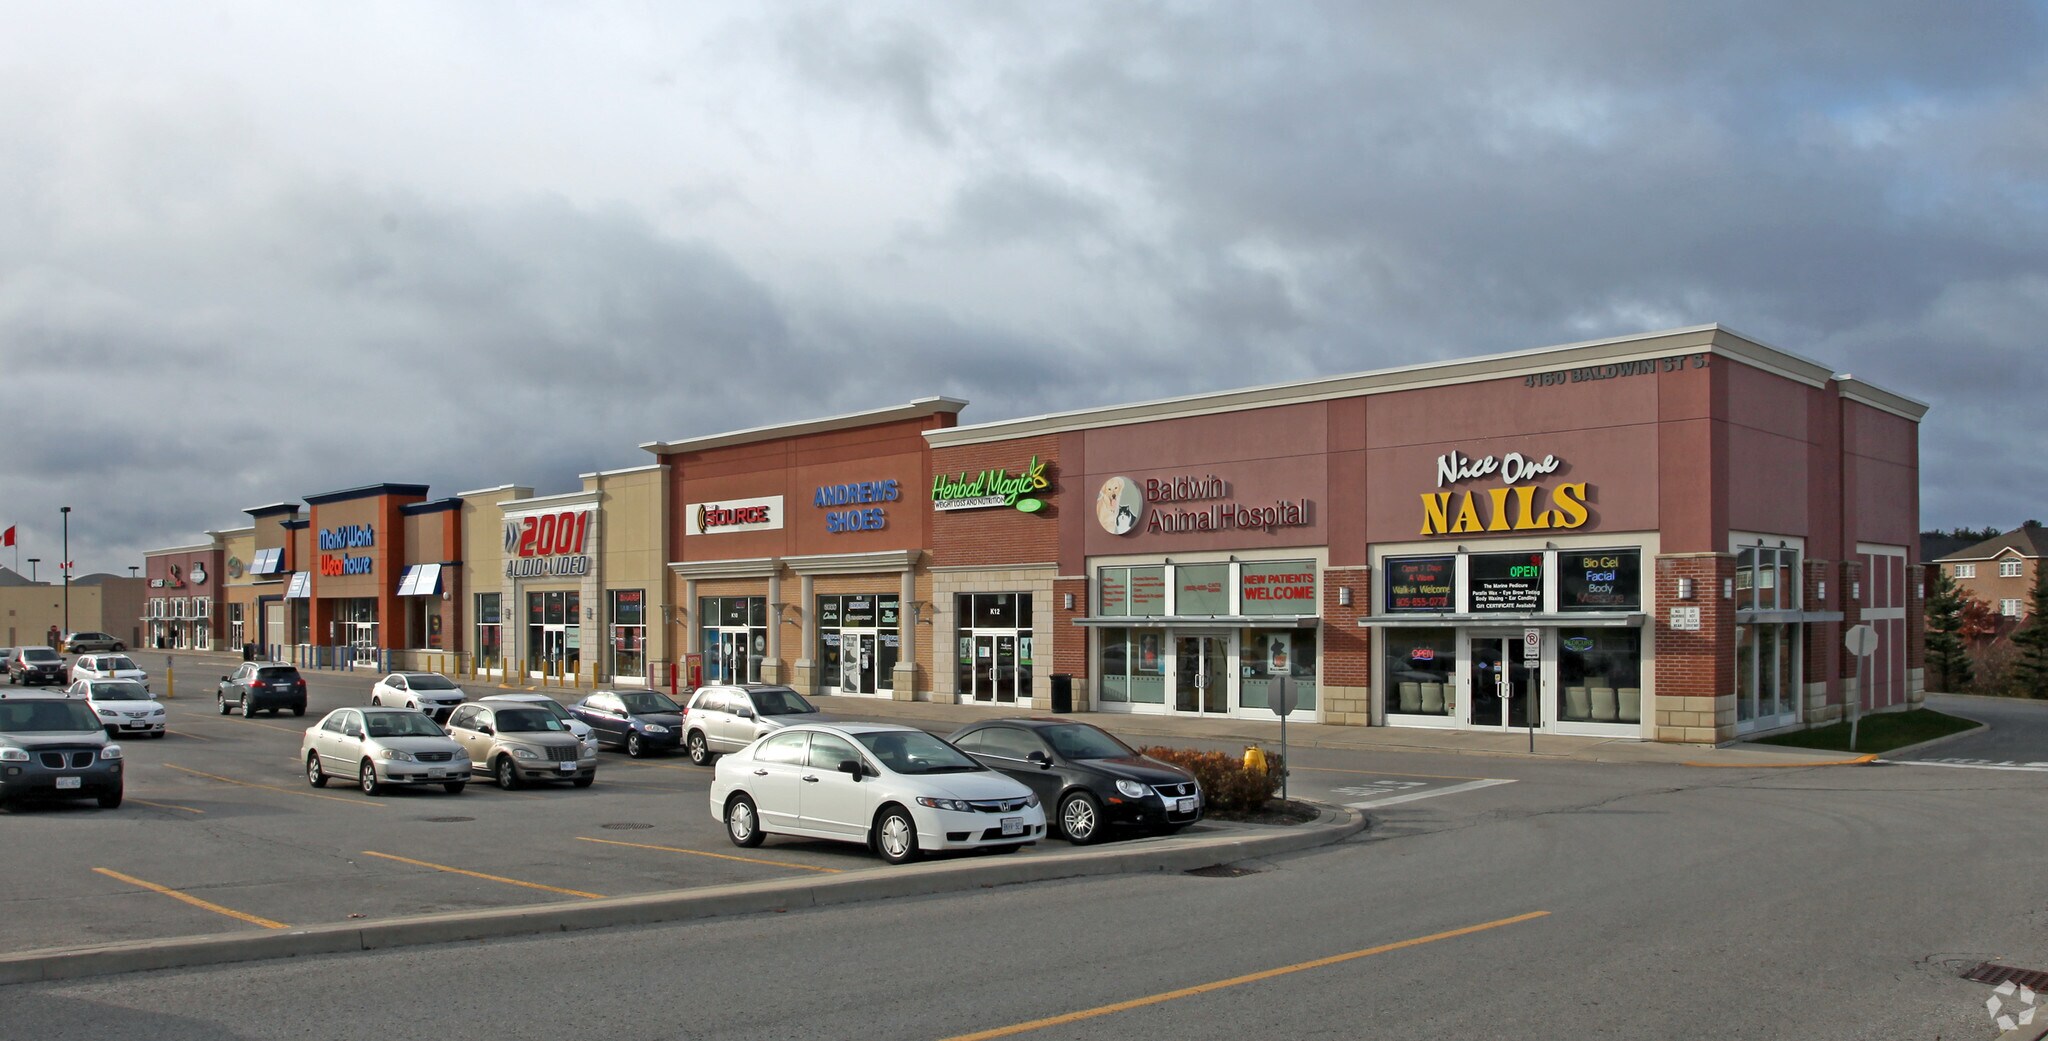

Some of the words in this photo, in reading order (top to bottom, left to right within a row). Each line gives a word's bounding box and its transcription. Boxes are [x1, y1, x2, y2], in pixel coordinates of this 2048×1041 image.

[1525, 372, 1566, 388] 4160
[1571, 359, 1656, 383] BALDWIN
[1662, 355, 1688, 372] ST
[1692, 353, 1710, 369] S.
[1437, 450, 1499, 487] Nice
[1501, 452, 1559, 484] One
[814, 479, 899, 508] ANDREWS
[931, 470, 987, 501] Herbal
[986, 469, 1034, 506] Magic
[1146, 474, 1224, 502] Baldwin
[935, 500, 954, 509] WEIGHT
[954, 499, 966, 507] LOSS
[966, 498, 978, 506] AND
[977, 496, 1005, 506] NUTRITION
[1420, 482, 1588, 535] NAILS
[706, 506, 769, 526] SOURCE
[826, 508, 885, 534] SHOES
[1147, 505, 1216, 532] Animal
[1220, 498, 1307, 532] Hospital
[320, 526, 347, 550] Mark's
[347, 523, 374, 548] Work
[519, 510, 588, 558] 2001
[320, 553, 372, 576] Wearhouse
[1510, 565, 1538, 577] OPEN
[1583, 557, 1599, 568] Bio
[1600, 556, 1619, 568] Gel
[1244, 574, 1266, 584] NEW
[1268, 573, 1314, 584] PATIENTS
[1585, 569, 1616, 581] Facial
[1244, 585, 1314, 601] WELCOME
[1419, 584, 1451, 594] Welcome
[1588, 583, 1614, 594] Body
[1411, 649, 1434, 659] OPEN
